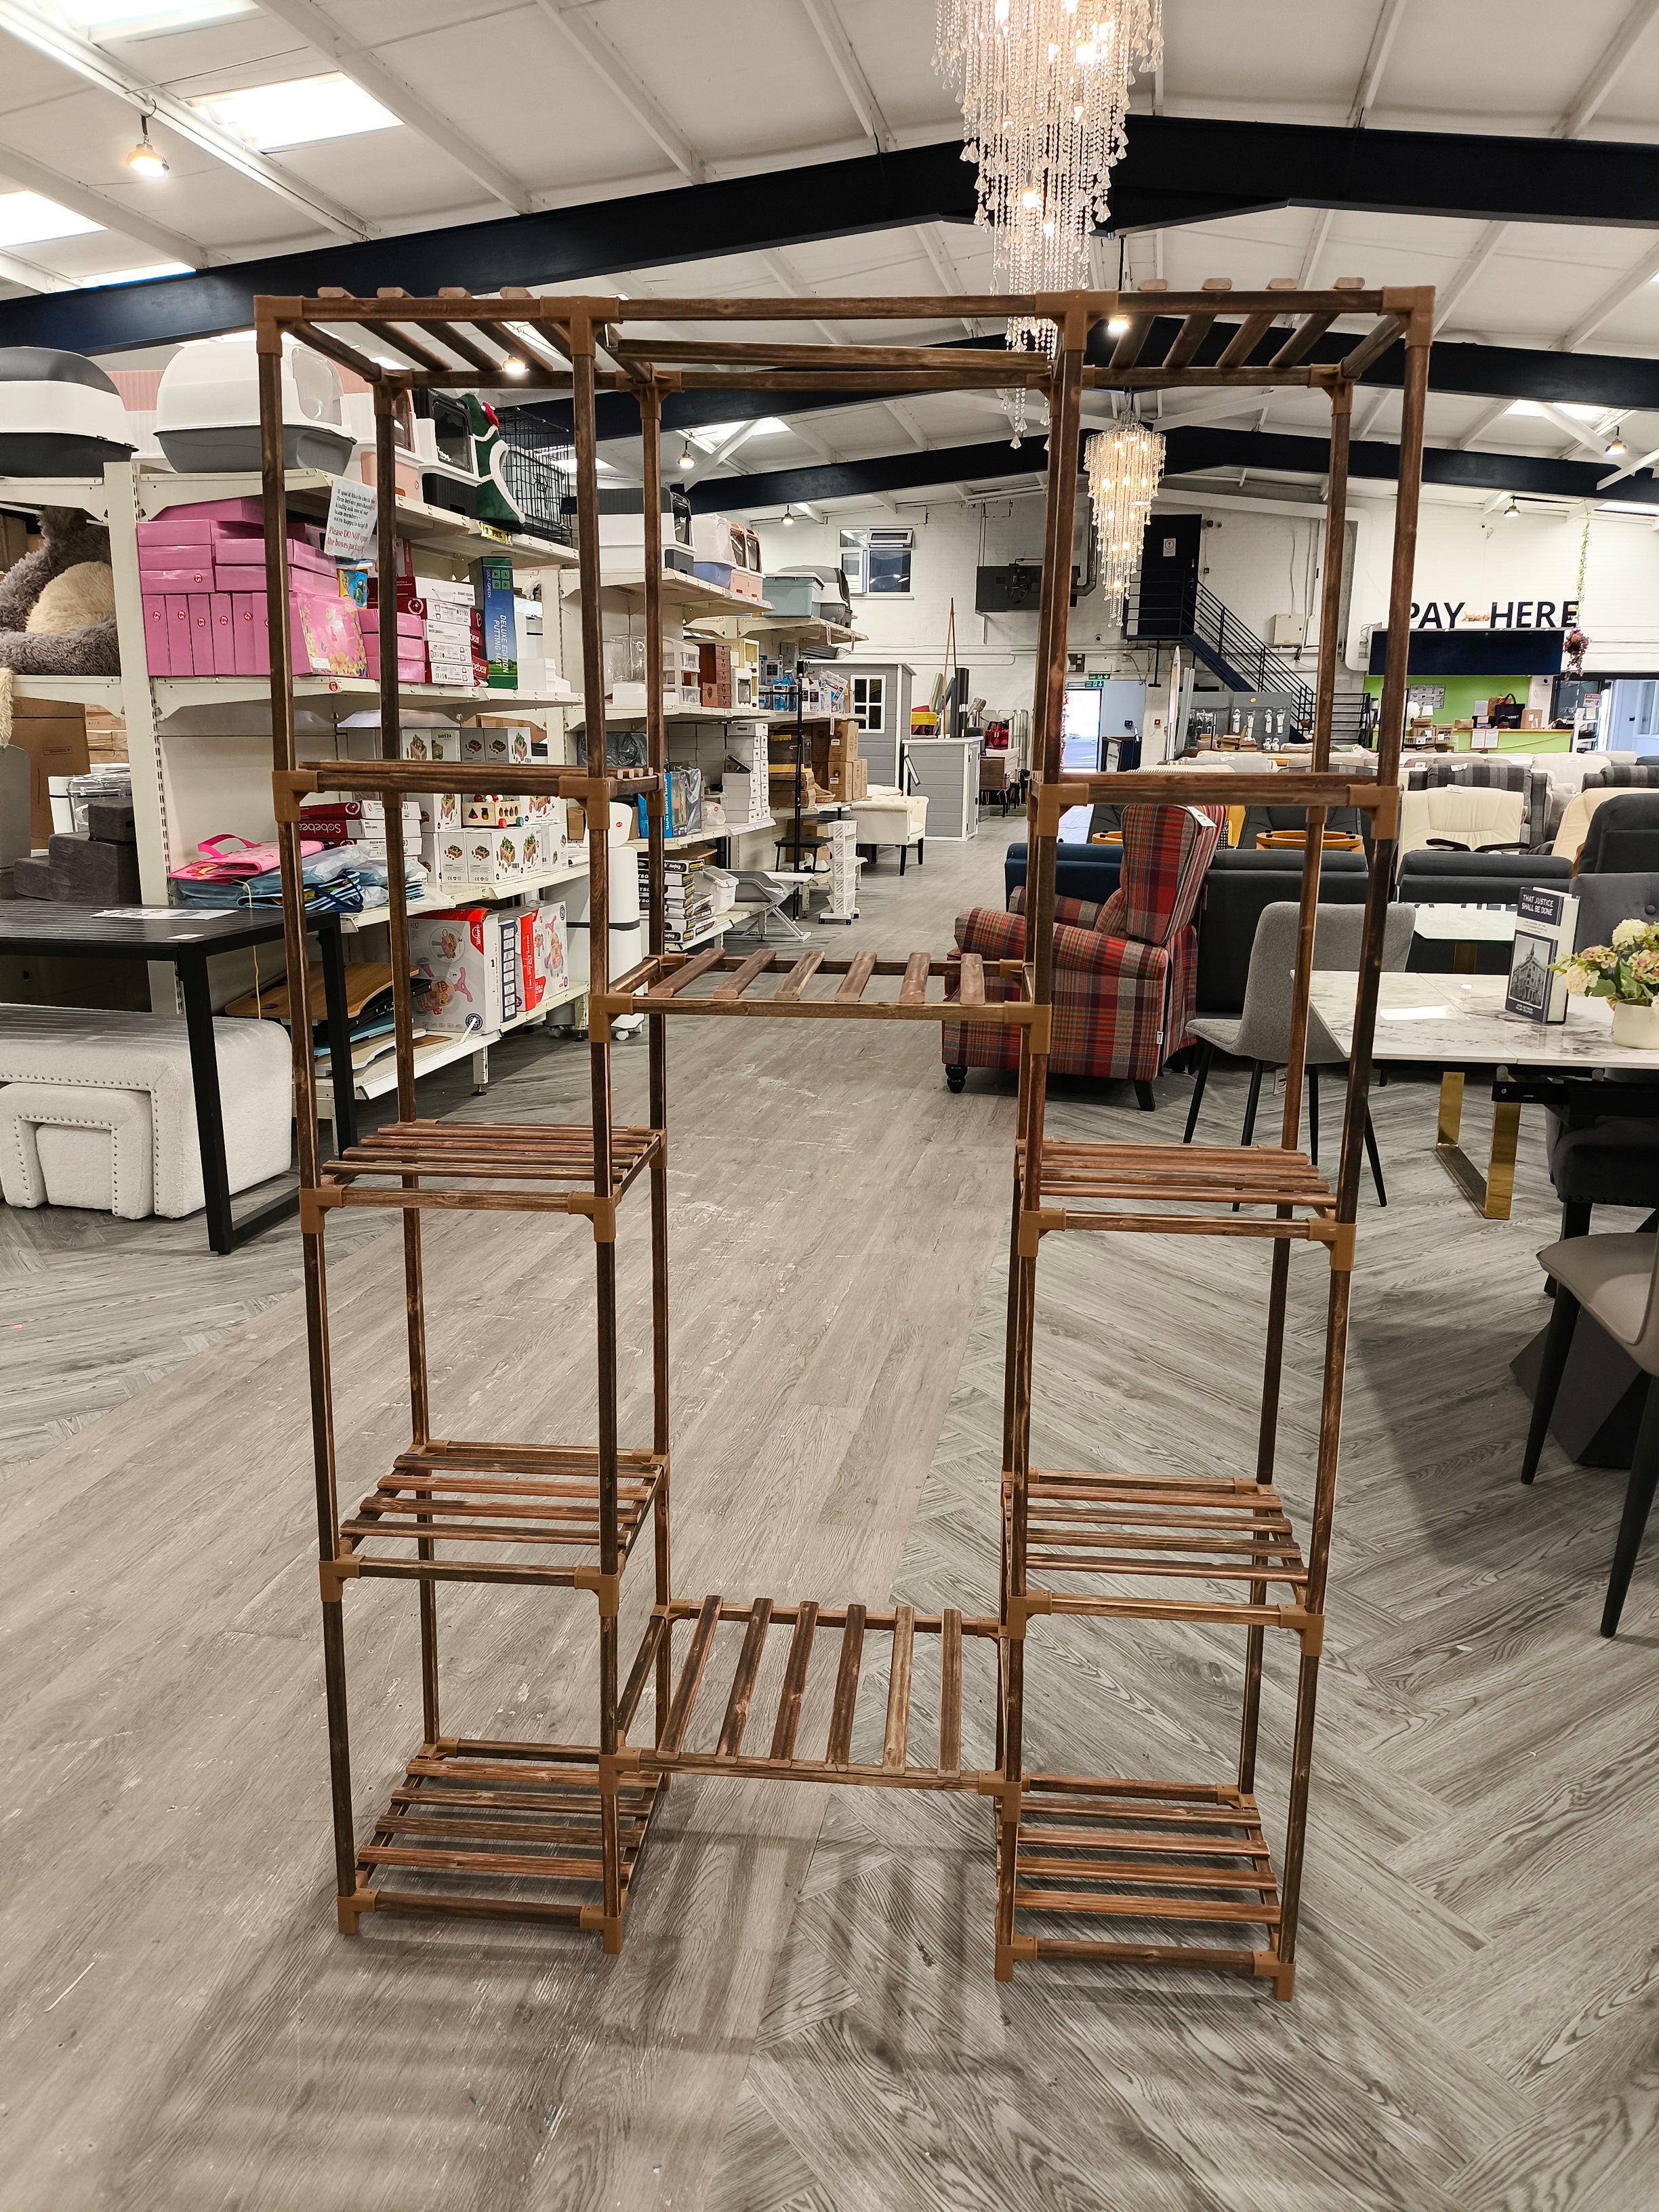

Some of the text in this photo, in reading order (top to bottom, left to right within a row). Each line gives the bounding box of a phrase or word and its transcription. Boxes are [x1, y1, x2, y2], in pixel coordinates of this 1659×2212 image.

[329, 526, 344, 537] Please
[344, 529, 351, 539] DO
[1490, 601, 1579, 629] HERE
[299, 823, 342, 834] Sobebea
[1523, 895, 1554, 907] THAT JUSTICE
[1521, 902, 1553, 916] SHALL BE DONE
